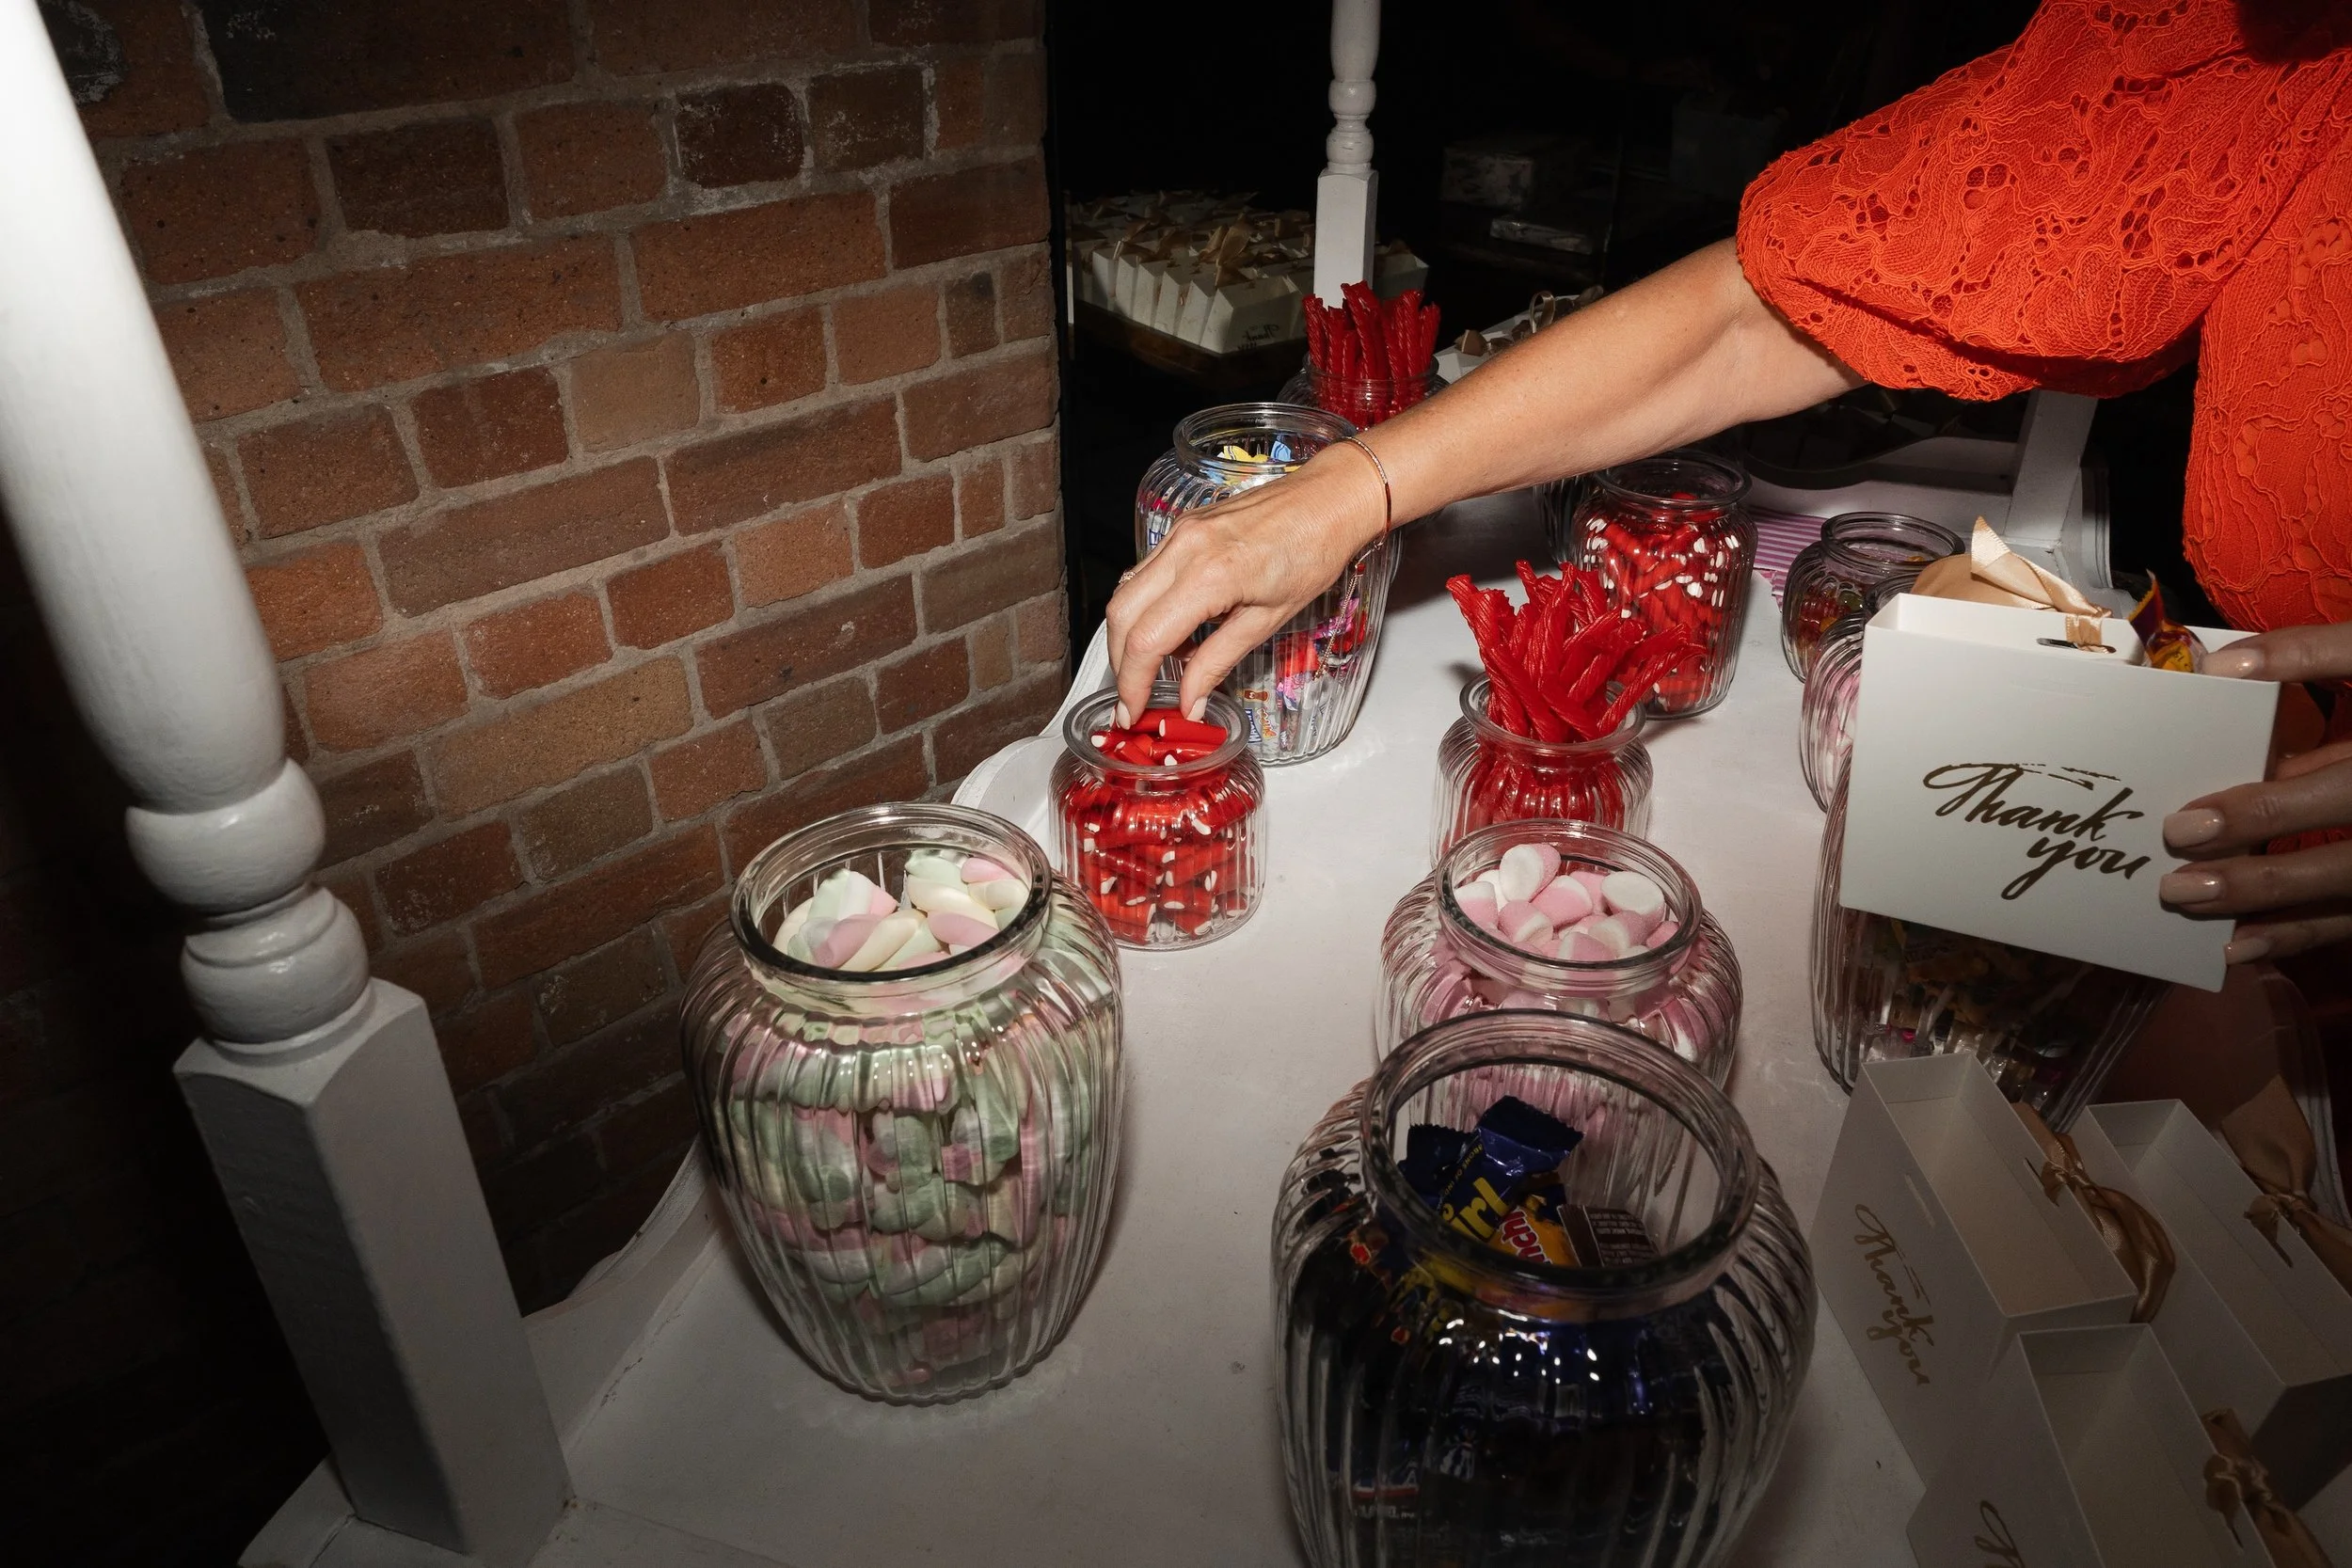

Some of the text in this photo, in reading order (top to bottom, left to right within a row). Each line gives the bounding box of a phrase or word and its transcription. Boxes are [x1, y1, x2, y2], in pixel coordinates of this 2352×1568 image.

[1923, 762, 2144, 841] Thank
[2001, 836, 2151, 900] you
[1439, 1177, 1509, 1243] irl
[1854, 1203, 1934, 1347] Thank
[1867, 1308, 1931, 1386] you
